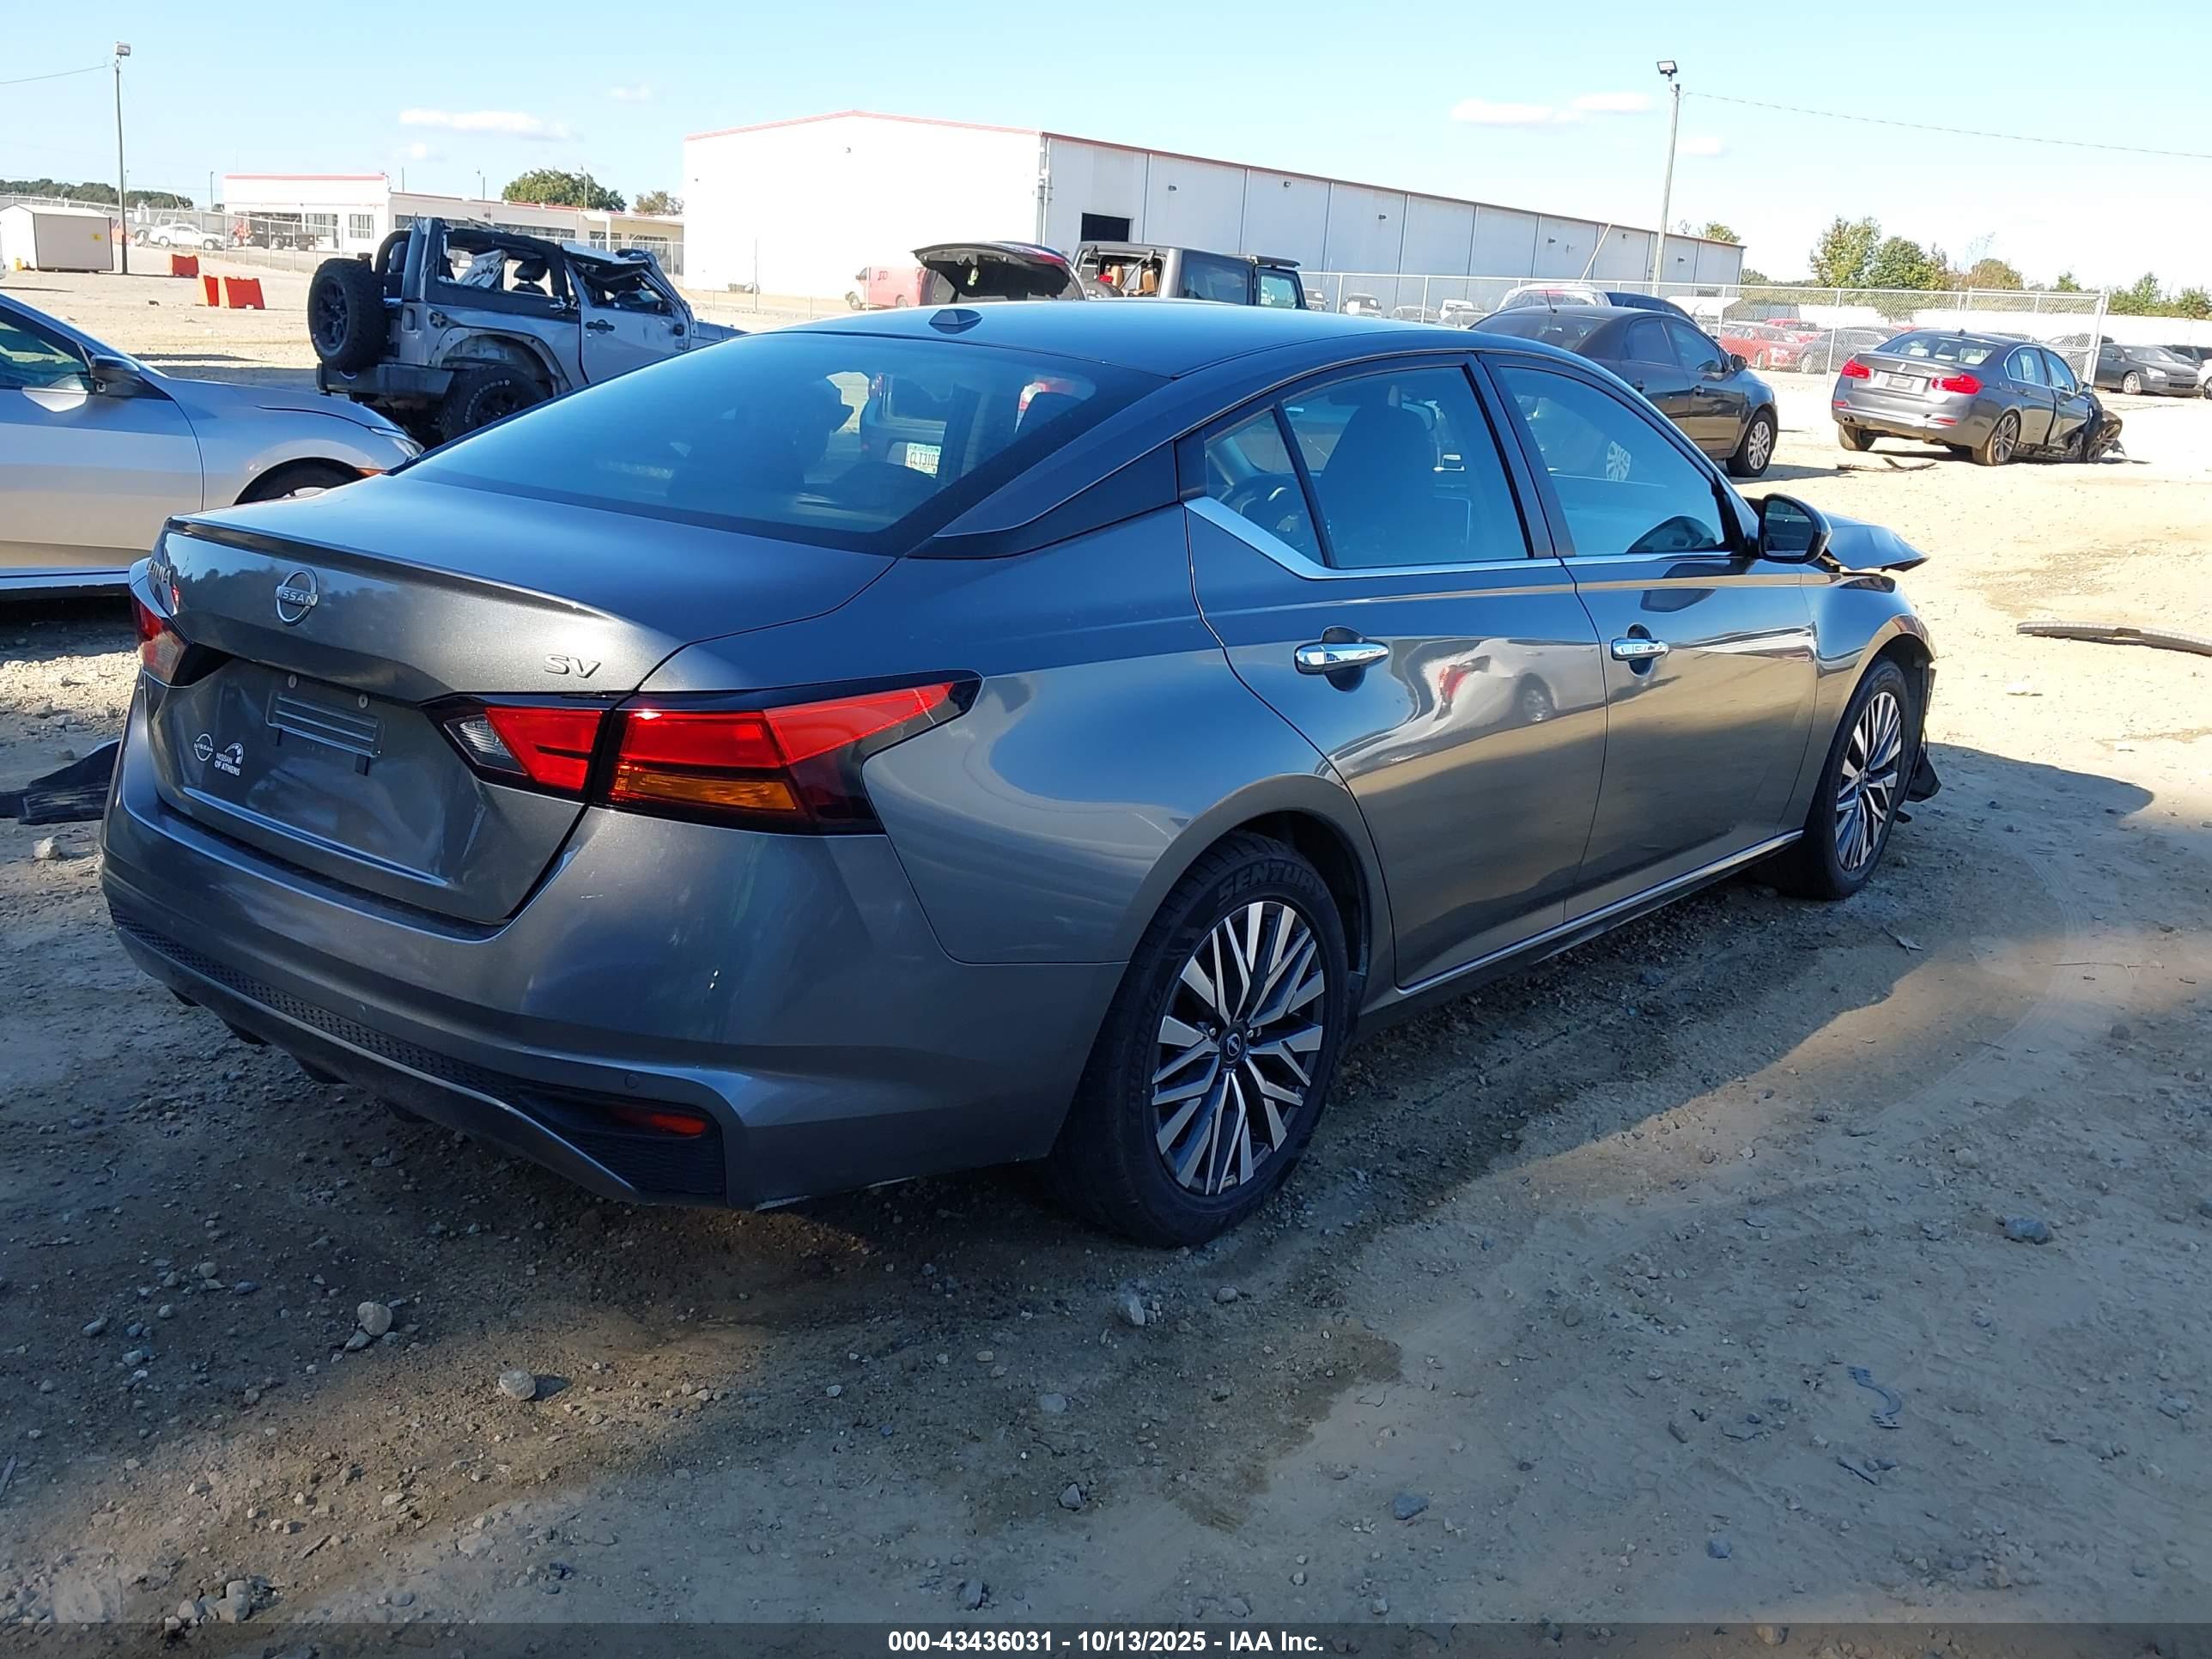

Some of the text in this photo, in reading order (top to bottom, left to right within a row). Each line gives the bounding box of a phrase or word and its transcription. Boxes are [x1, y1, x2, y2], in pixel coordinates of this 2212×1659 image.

[544, 653, 602, 678] SV
[193, 742, 214, 753] NISSAN
[216, 752, 234, 765] NISSAN
[214, 760, 241, 776] OF ATHENS
